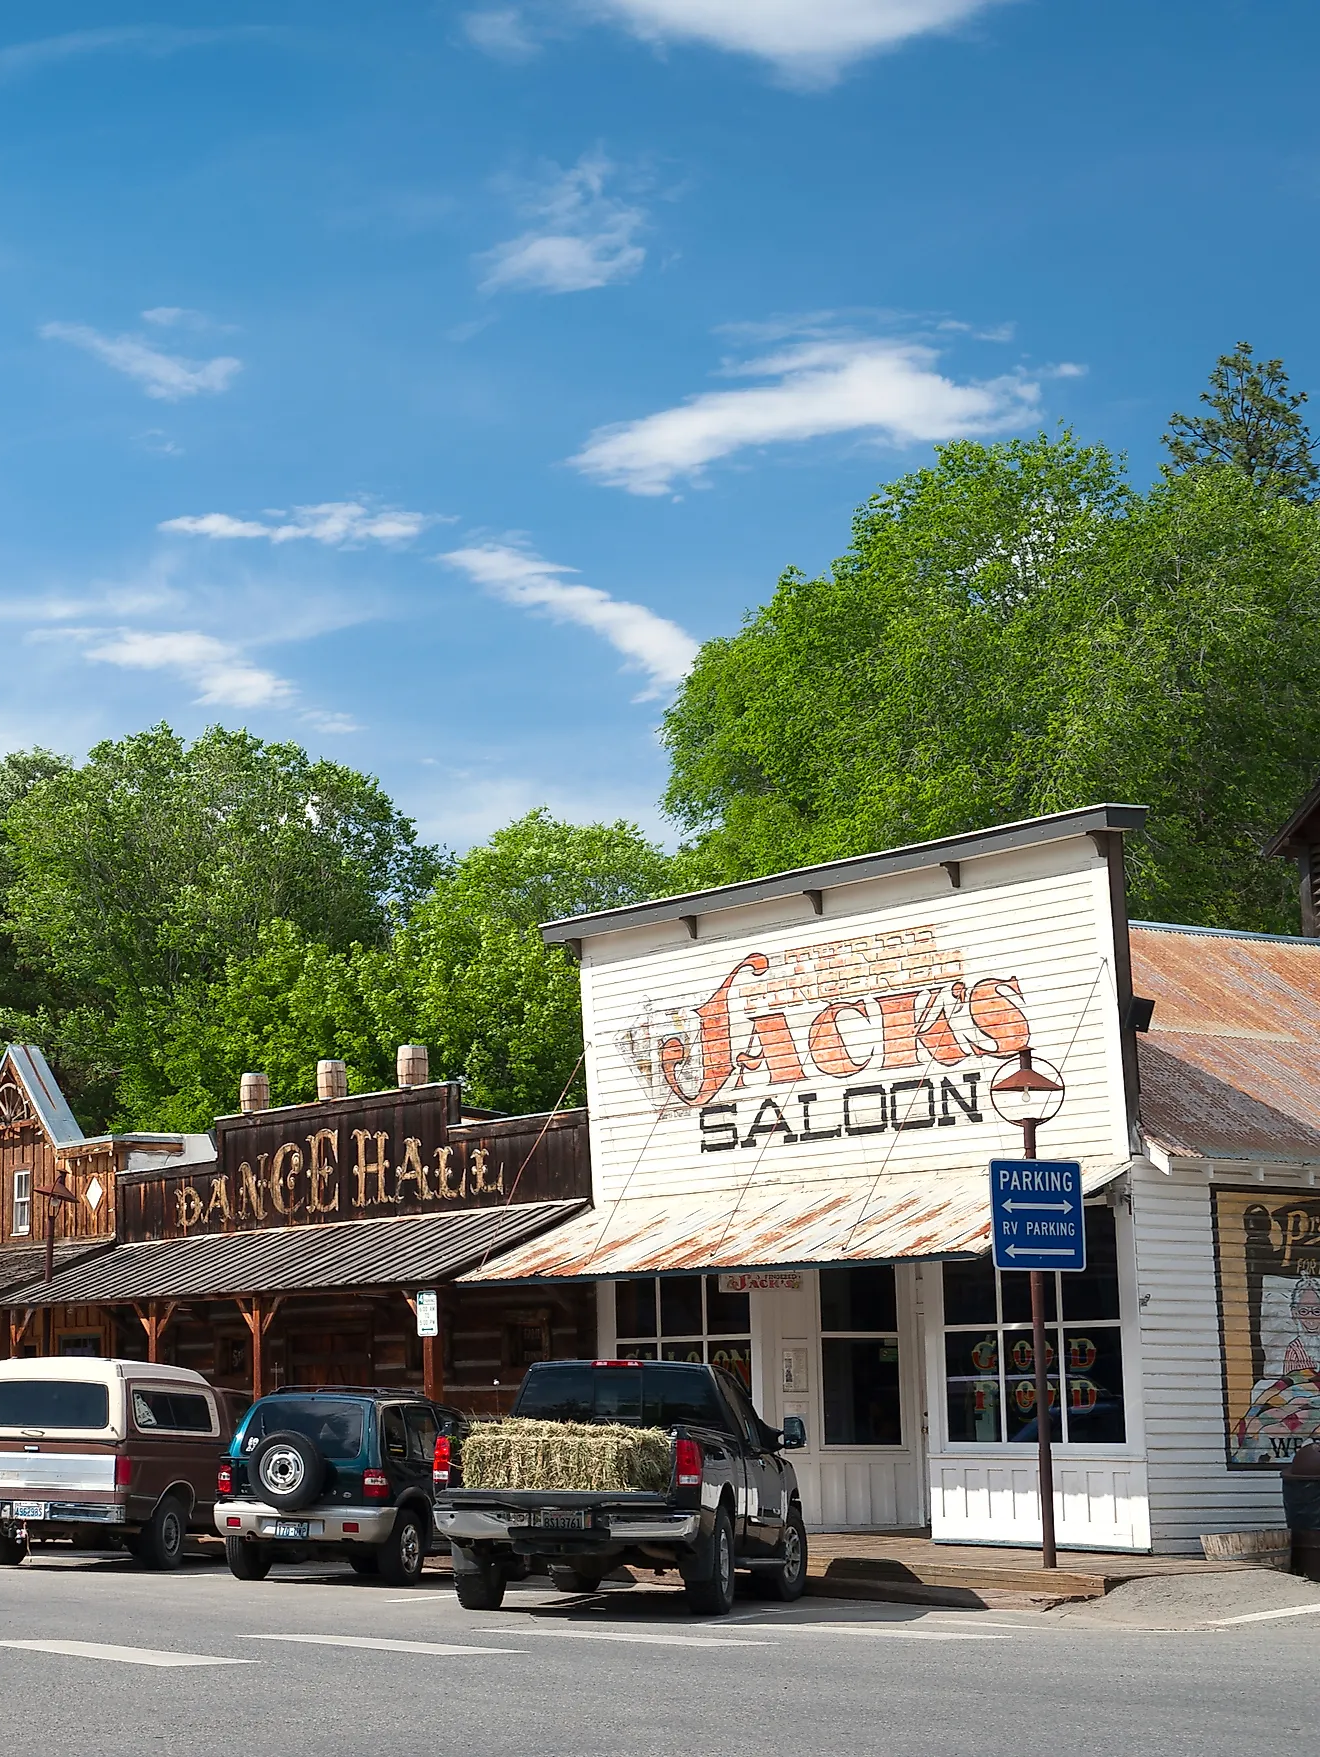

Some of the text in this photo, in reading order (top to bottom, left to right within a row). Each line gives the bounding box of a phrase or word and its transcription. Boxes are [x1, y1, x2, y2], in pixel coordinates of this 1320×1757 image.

[698, 1071, 984, 1154] SALOON
[175, 1127, 505, 1227] DANCE HALL
[999, 1170, 1073, 1192] PARKING
[1002, 1221, 1076, 1237] RV PARKING
